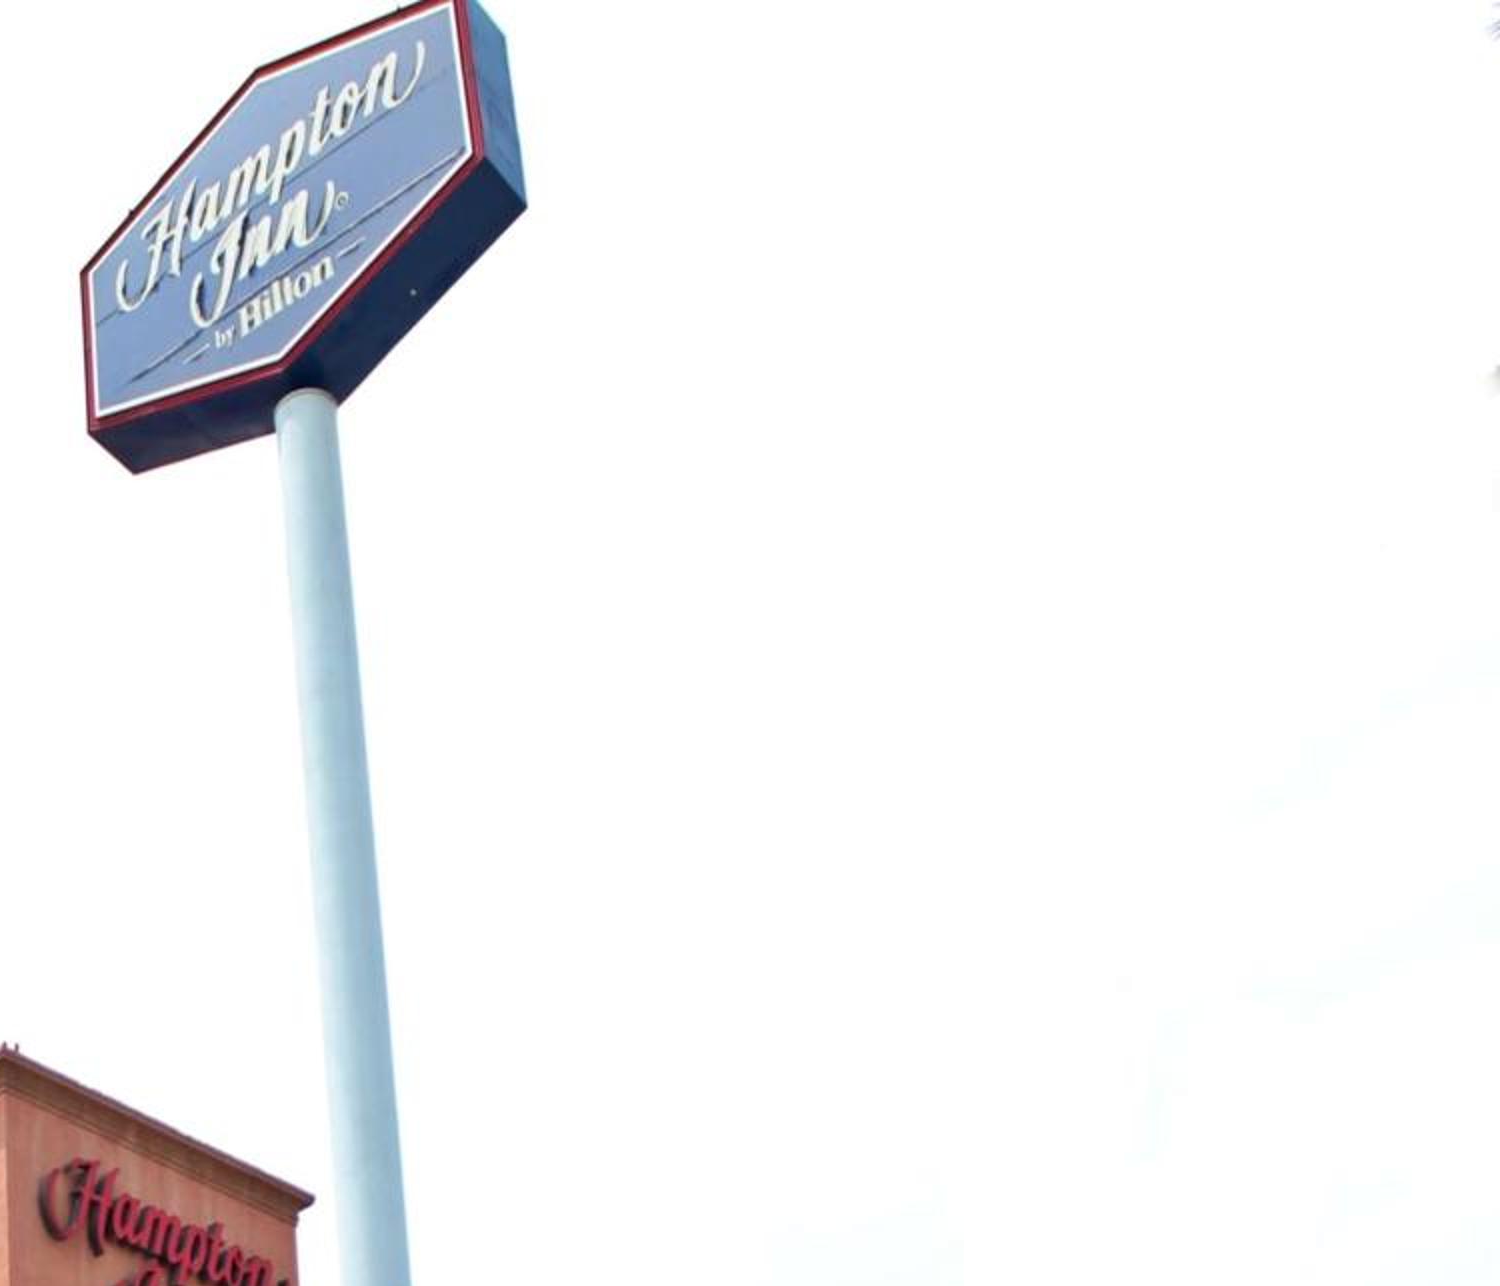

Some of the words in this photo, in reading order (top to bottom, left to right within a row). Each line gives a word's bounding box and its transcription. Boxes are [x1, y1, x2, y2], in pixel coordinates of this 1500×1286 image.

[115, 40, 426, 312] Hampton
[190, 180, 335, 328] Inn
[214, 324, 237, 349] by
[239, 254, 335, 338] Hilton
